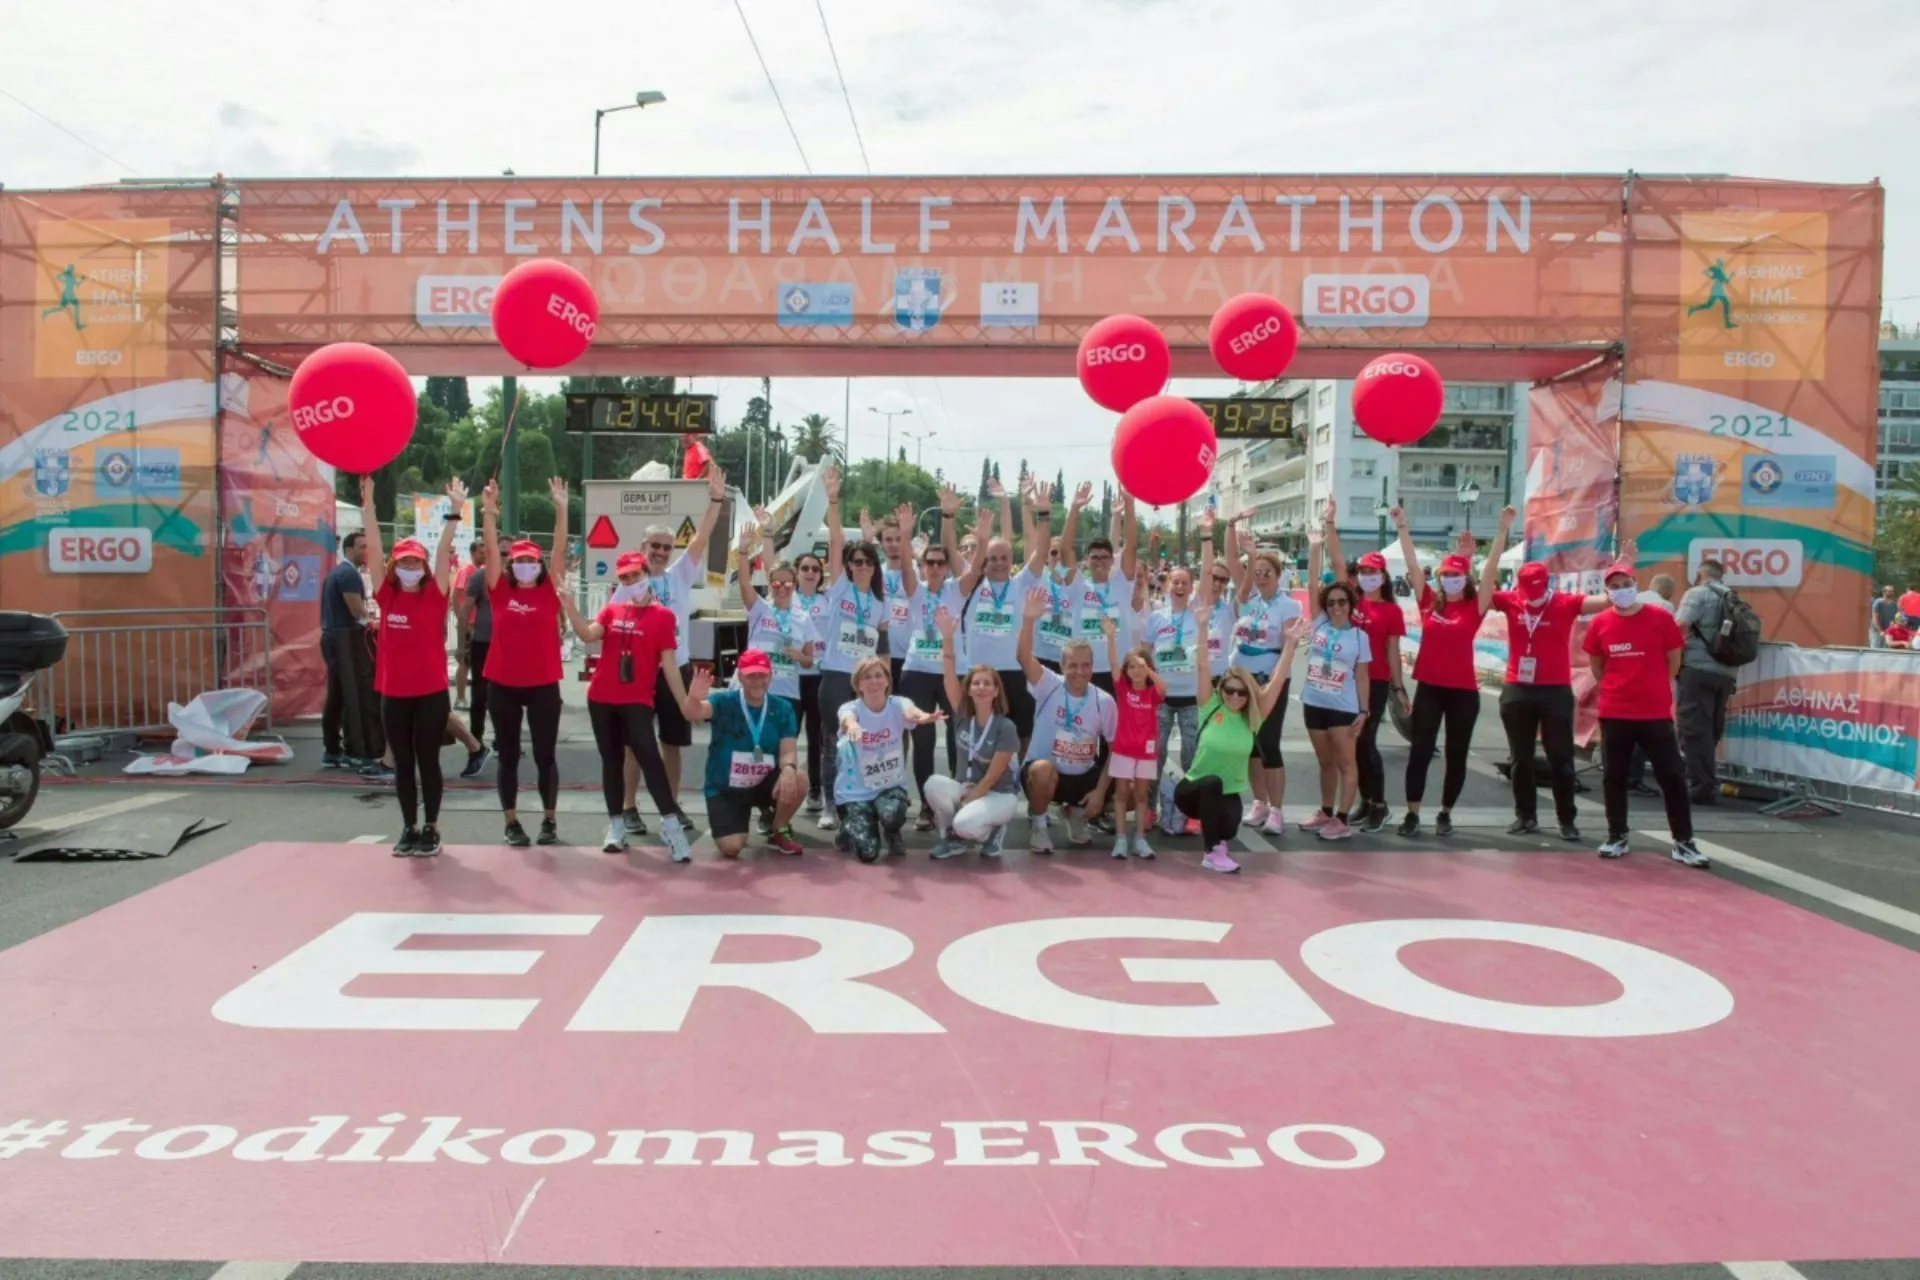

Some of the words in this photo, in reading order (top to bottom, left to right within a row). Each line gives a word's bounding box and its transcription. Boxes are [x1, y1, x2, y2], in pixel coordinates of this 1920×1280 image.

[317, 198, 666, 255] ATHENS
[729, 196, 953, 254] HALF
[1014, 195, 1531, 254] MARATHON
[428, 285, 493, 314] ERG
[1317, 285, 1415, 314] ERGO
[546, 293, 597, 342] ERGO
[1229, 316, 1282, 355] ERGO
[75, 350, 122, 366] ERGO
[1086, 343, 1146, 367] ERGO
[1724, 352, 1776, 368] ERGO
[1363, 361, 1421, 380] ERGO
[63, 410, 137, 431] 2021
[292, 396, 354, 431] ERGO
[1709, 415, 1793, 437] 2021
[60, 537, 141, 562] ERGO
[1609, 643, 1632, 653] ERGO
[1774, 686, 1861, 714] ΑΘΗΝΑΣ
[862, 728, 891, 745] ERGO
[1738, 710, 1906, 747] ΗΜΙΜΑΡΑΘΩΝΙΟΣ
[865, 757, 899, 777] 24157
[211, 912, 1735, 1038] ERGO
[0, 1112, 1385, 1170] #todikomasERGO
